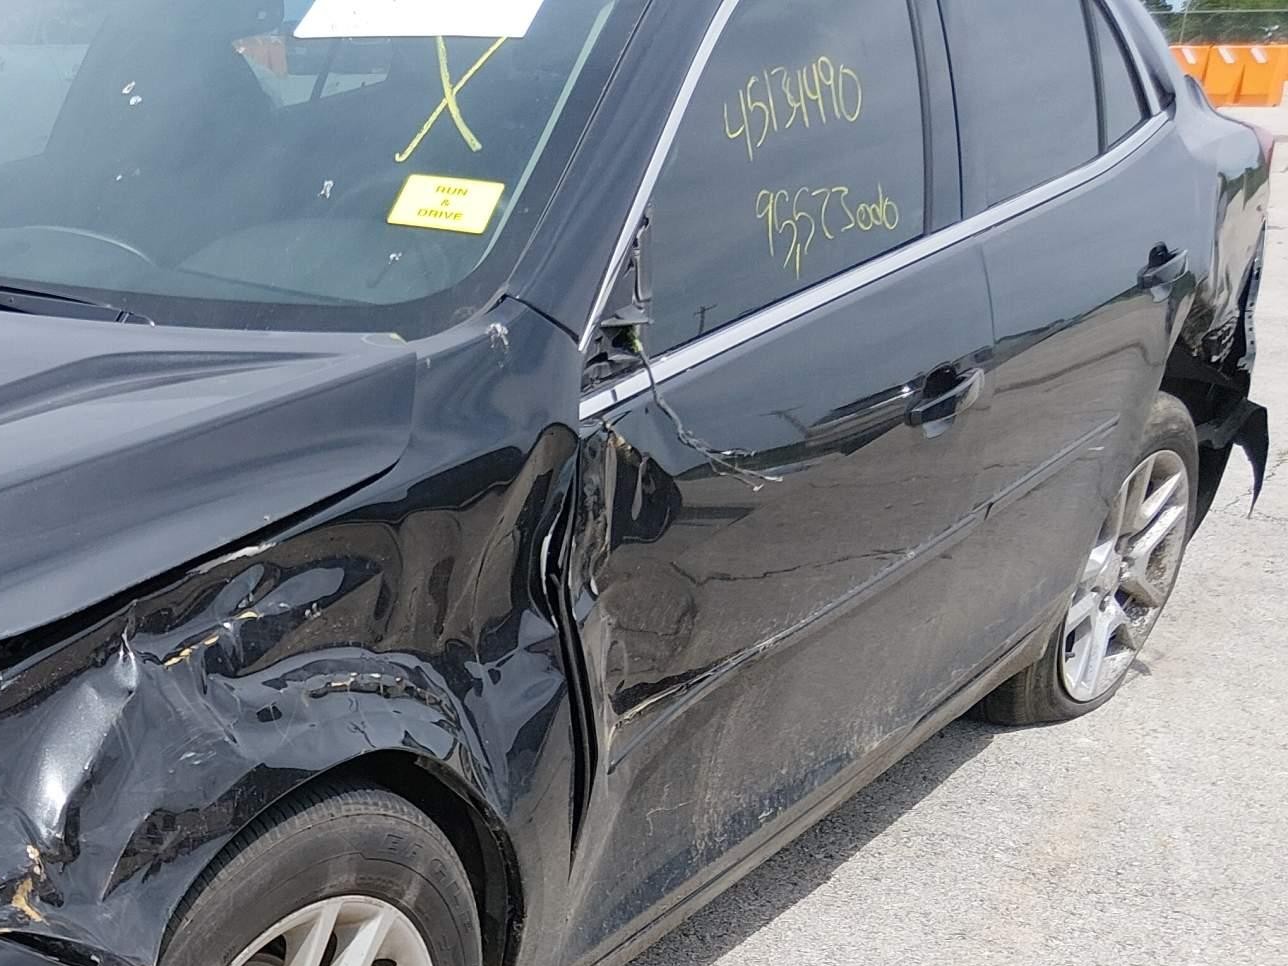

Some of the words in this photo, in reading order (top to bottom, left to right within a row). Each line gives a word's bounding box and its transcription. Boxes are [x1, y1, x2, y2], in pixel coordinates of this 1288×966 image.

[723, 55, 862, 162] 45134490
[435, 185, 469, 196] RUN
[440, 199, 450, 207] &
[417, 208, 463, 221] DRIVE
